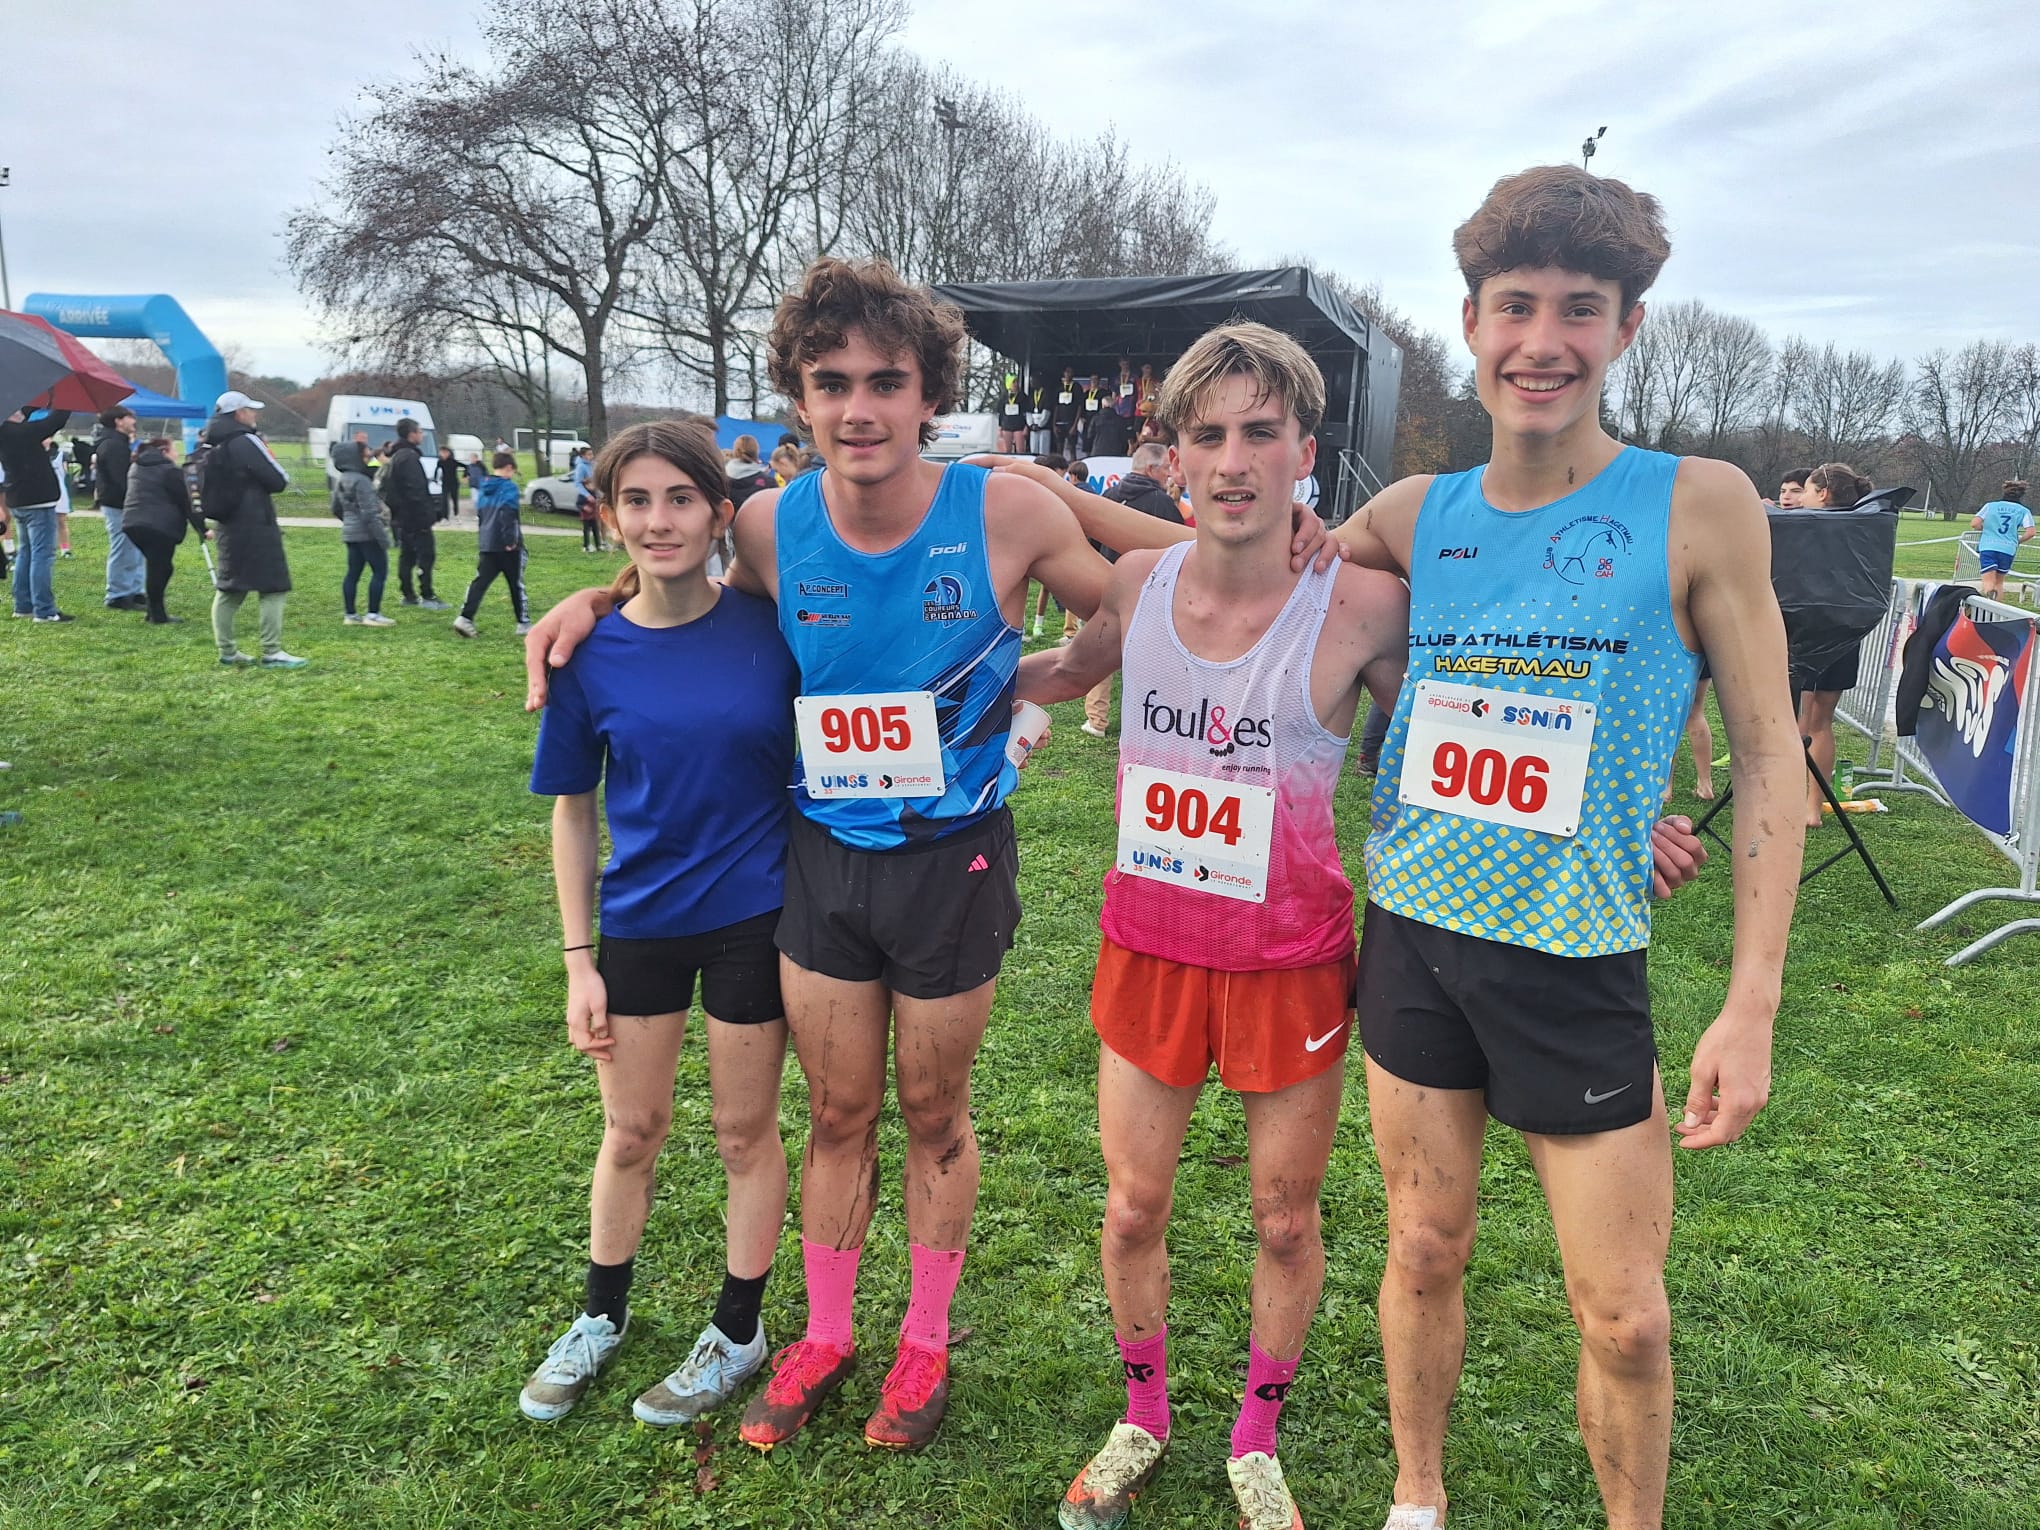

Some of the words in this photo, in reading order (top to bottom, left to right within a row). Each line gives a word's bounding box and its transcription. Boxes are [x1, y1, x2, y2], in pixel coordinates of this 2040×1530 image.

[1997, 515, 2012, 534] 3
[1438, 547, 1478, 560] POLI
[1594, 570, 1614, 578] CAH
[1461, 632, 1630, 655] ATHLÉTISME
[1434, 655, 1591, 680] HAGETMAU
[1428, 697, 1471, 712] Gironde
[1503, 706, 1572, 730] UNSS
[820, 706, 912, 753] 905
[1221, 764, 1241, 772] enjoy
[1242, 764, 1271, 775] running
[1431, 741, 1550, 814] 906
[820, 774, 869, 788] UNSS
[893, 775, 932, 784] Gironde
[1145, 782, 1242, 847] 904
[1132, 850, 1184, 874] UNSS
[1210, 870, 1253, 886] Gironde
